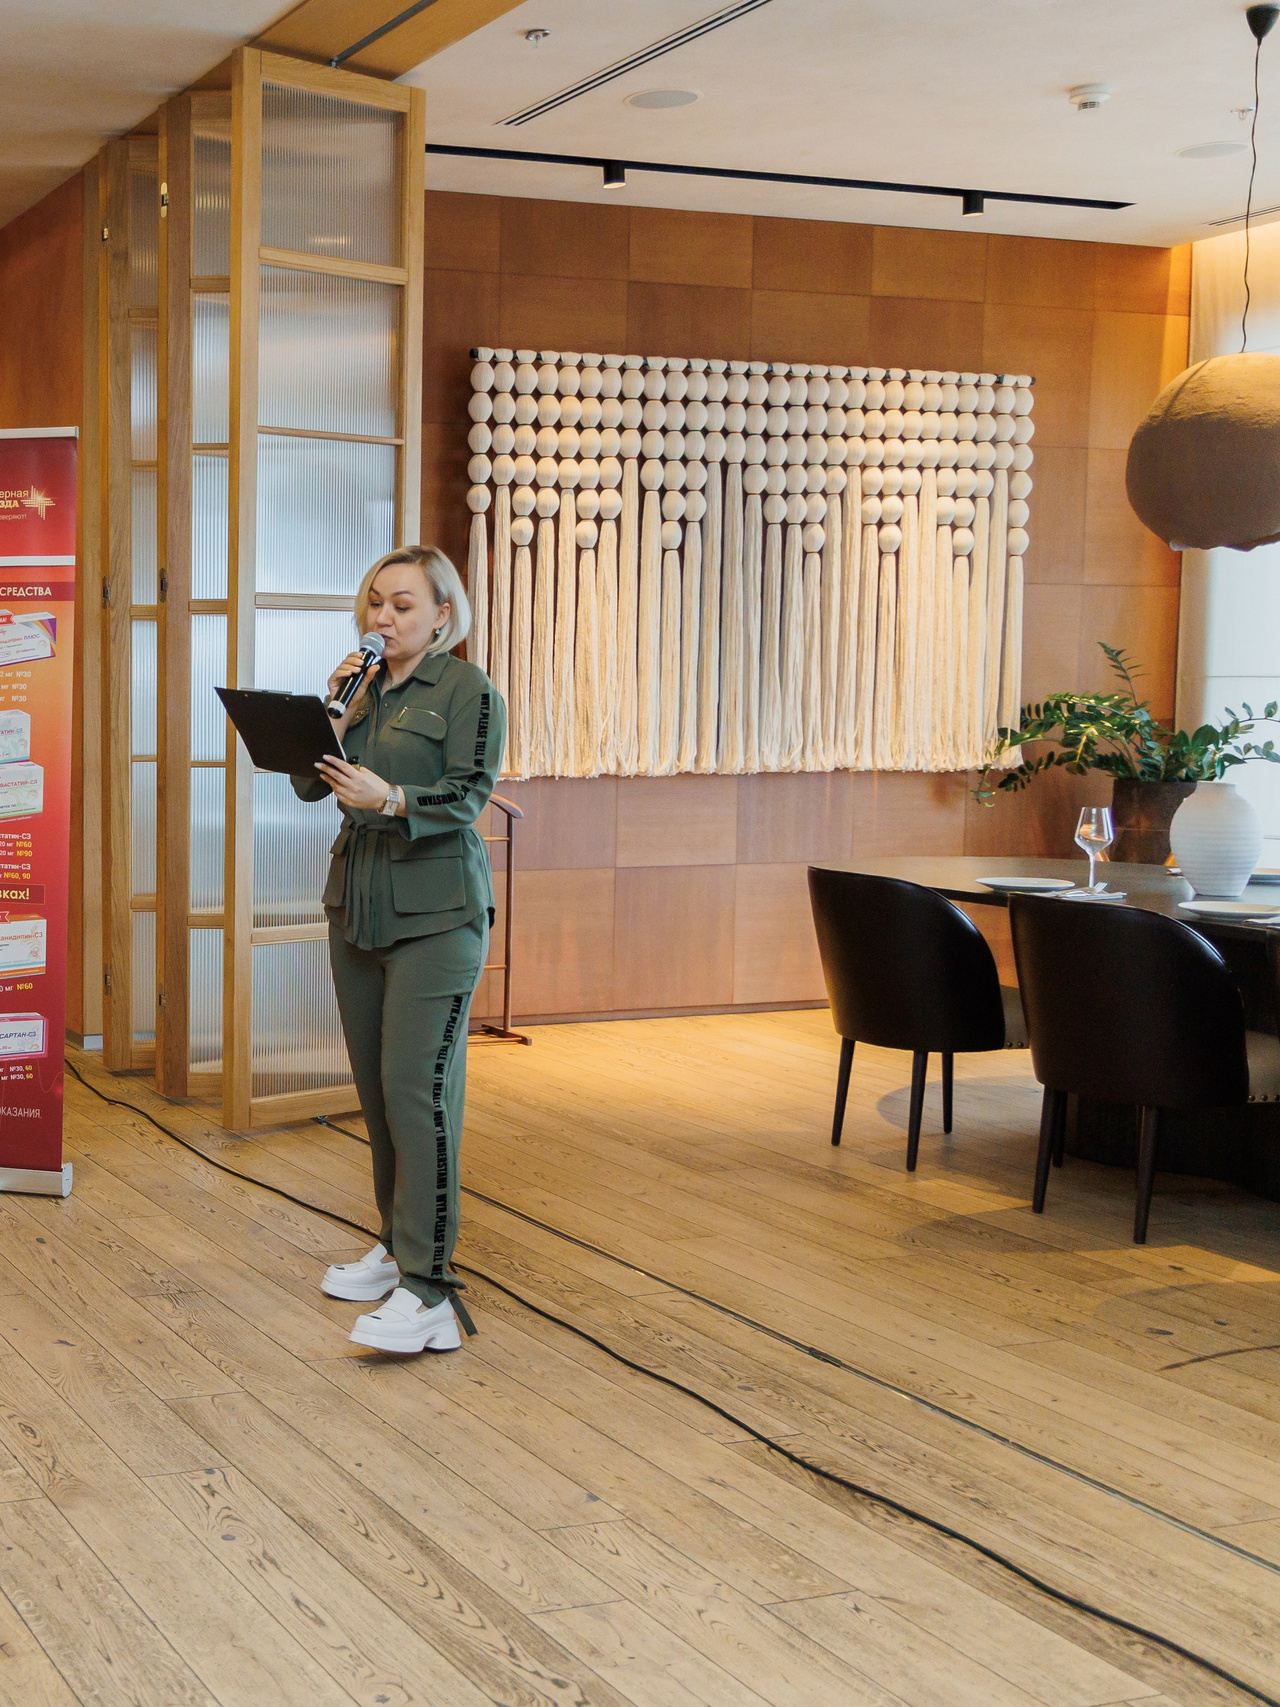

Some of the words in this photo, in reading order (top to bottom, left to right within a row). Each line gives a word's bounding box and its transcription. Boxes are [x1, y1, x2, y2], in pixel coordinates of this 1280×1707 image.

[475, 741, 486, 756] TELL
[437, 1044, 449, 1060] TELL
[434, 1063, 445, 1075] ME
[432, 1082, 443, 1109] REALLY
[433, 1110, 445, 1134] DON'T
[436, 1135, 447, 1190] UNDERSTAND
[433, 1244, 445, 1262] TELL
[431, 1263, 443, 1277] ME
